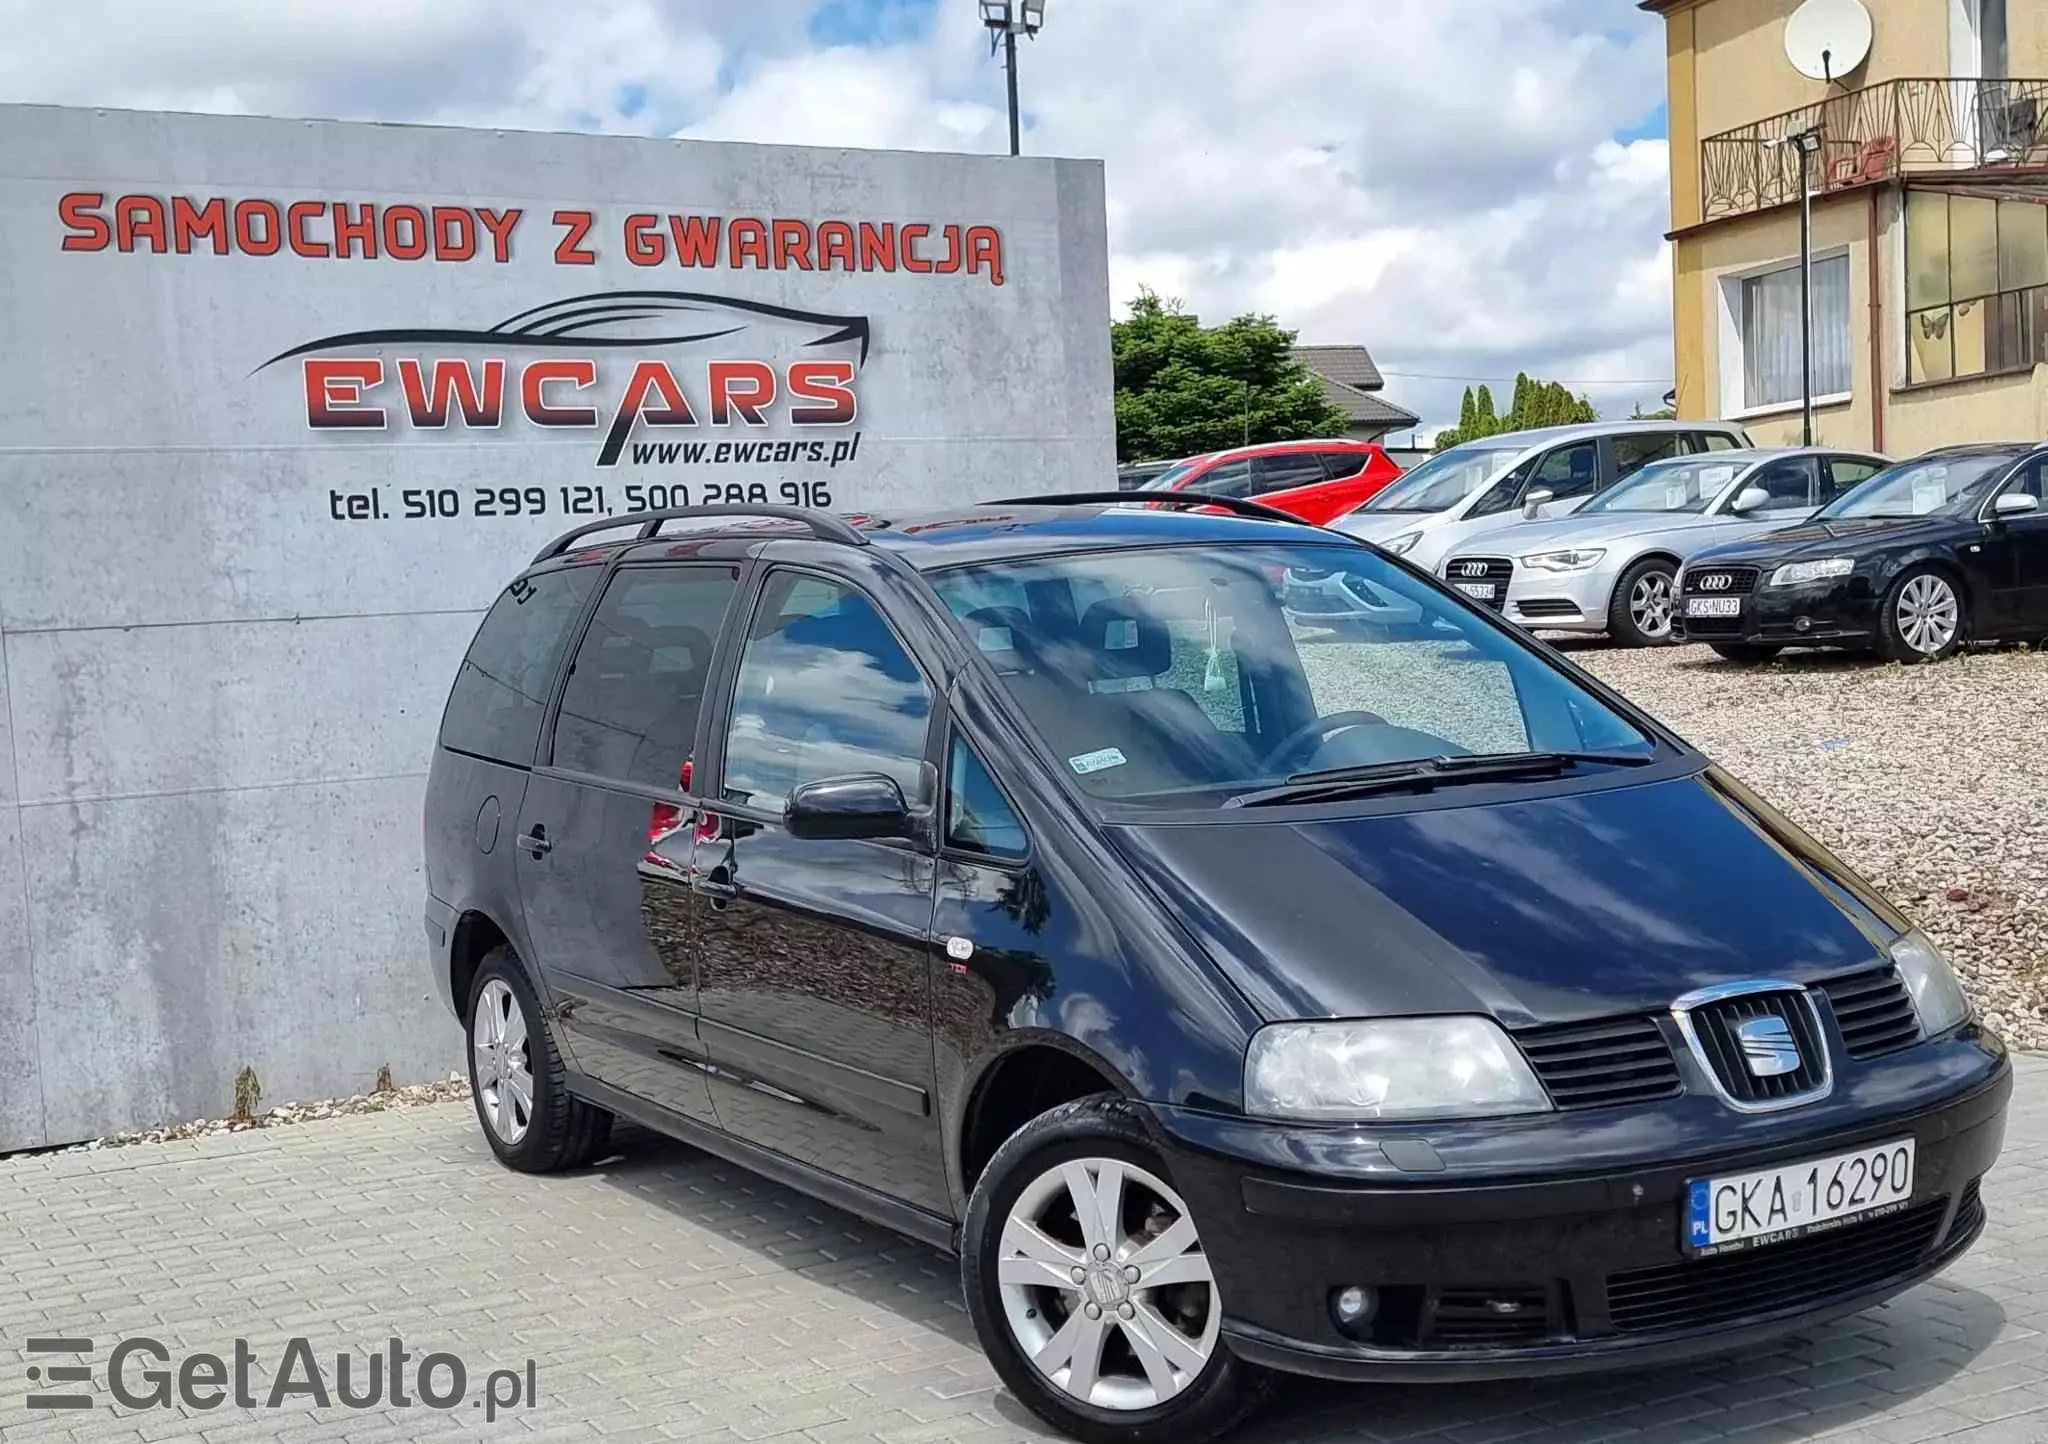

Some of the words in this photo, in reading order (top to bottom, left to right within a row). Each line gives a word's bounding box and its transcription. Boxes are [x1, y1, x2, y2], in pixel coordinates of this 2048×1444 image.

[58, 192, 522, 263] SAMOCHODY
[552, 210, 595, 265] Z
[624, 213, 1005, 286] GWARANCJĄ
[303, 358, 858, 467] EWCARS
[631, 431, 861, 468] www.ewcars.pl
[329, 487, 389, 520] tel.
[402, 488, 459, 518] 510
[474, 487, 546, 516] 299
[559, 485, 613, 517] 121,
[625, 484, 689, 513] 500
[702, 482, 769, 504] 288
[780, 481, 832, 508] 916
[1715, 1175, 1788, 1234] GKA
[1806, 1147, 1909, 1216] 16290
[1691, 1220, 1708, 1236] PL
